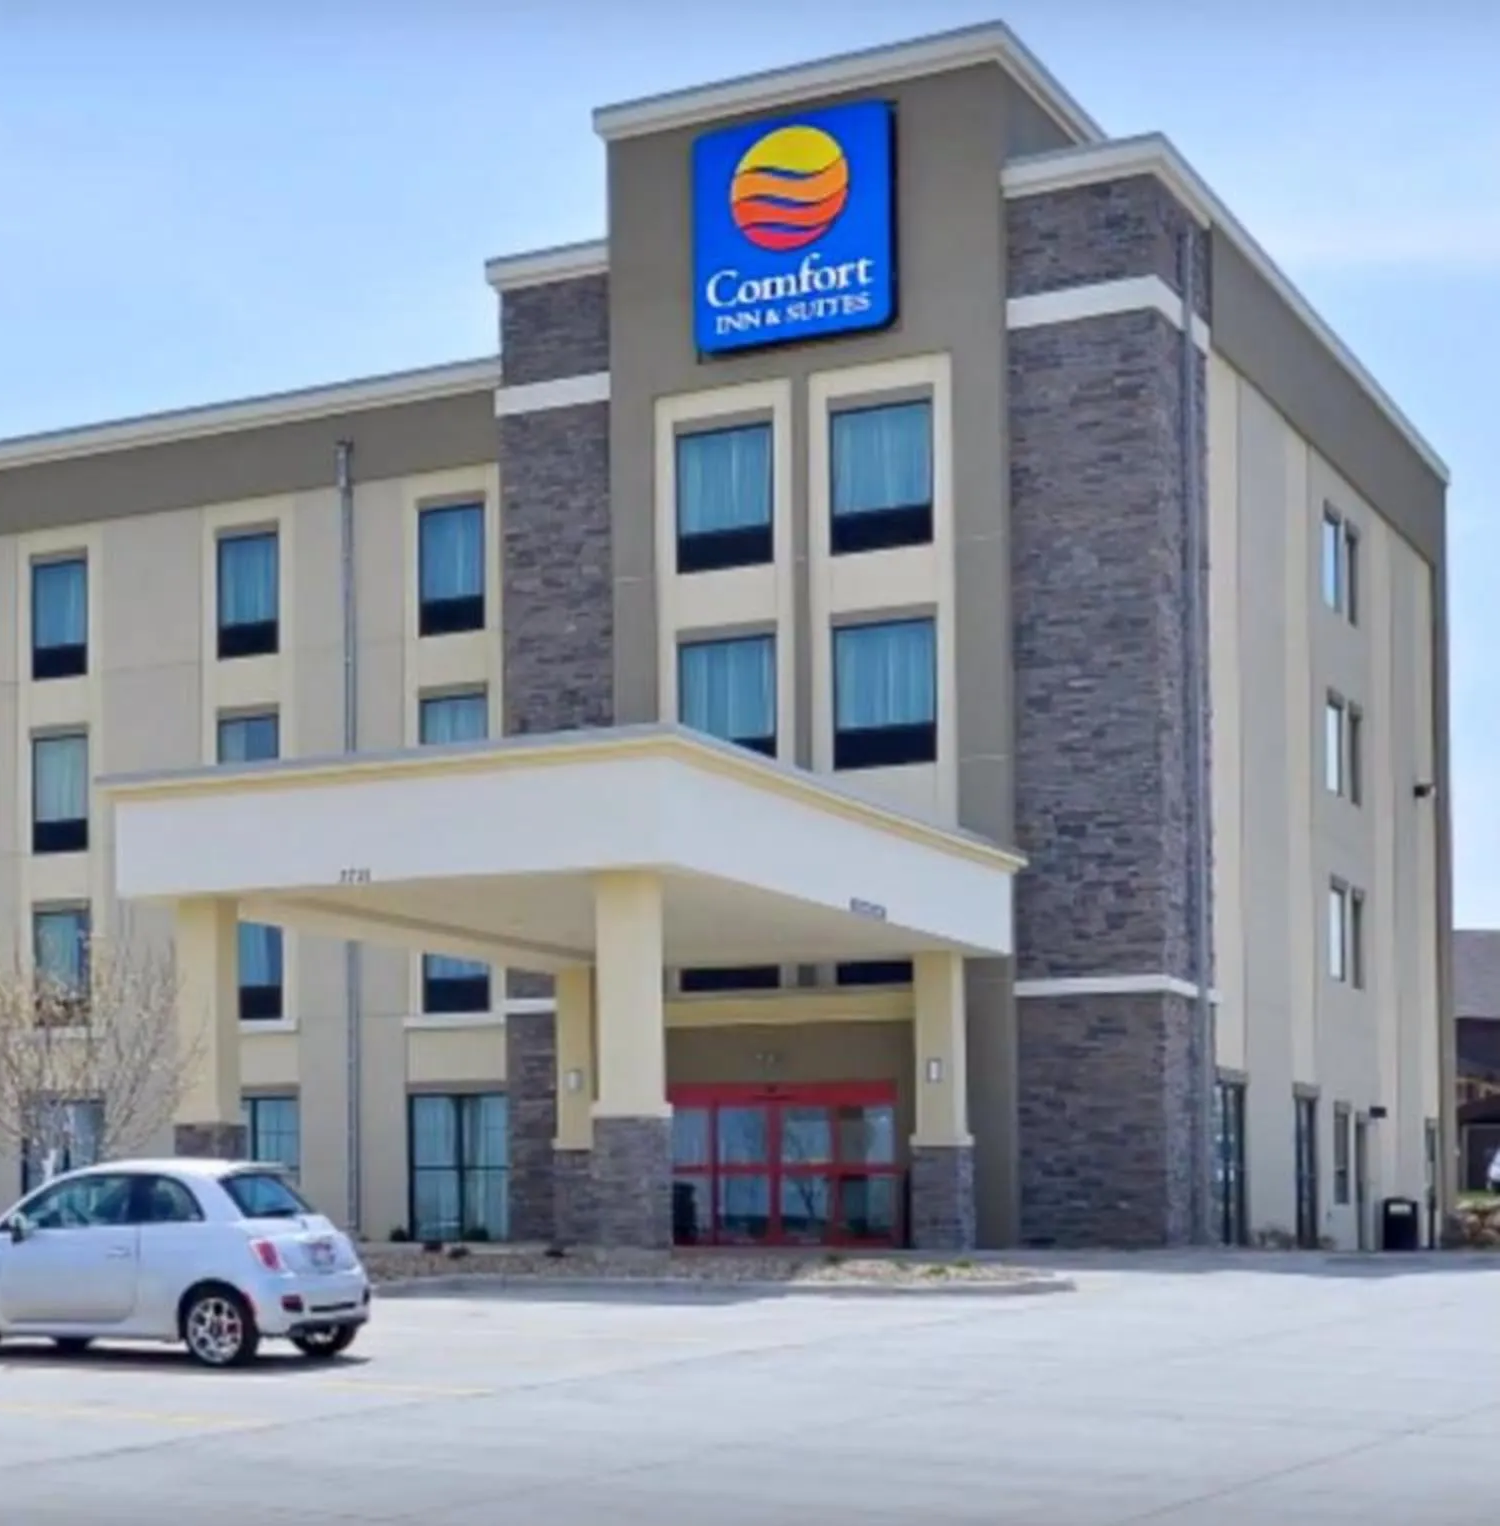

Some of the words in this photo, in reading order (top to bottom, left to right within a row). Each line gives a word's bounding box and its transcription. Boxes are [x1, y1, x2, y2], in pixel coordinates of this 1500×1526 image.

[706, 252, 874, 308] Comfort
[716, 309, 760, 334] INN
[765, 307, 781, 325] &
[786, 292, 872, 321] SUITES
